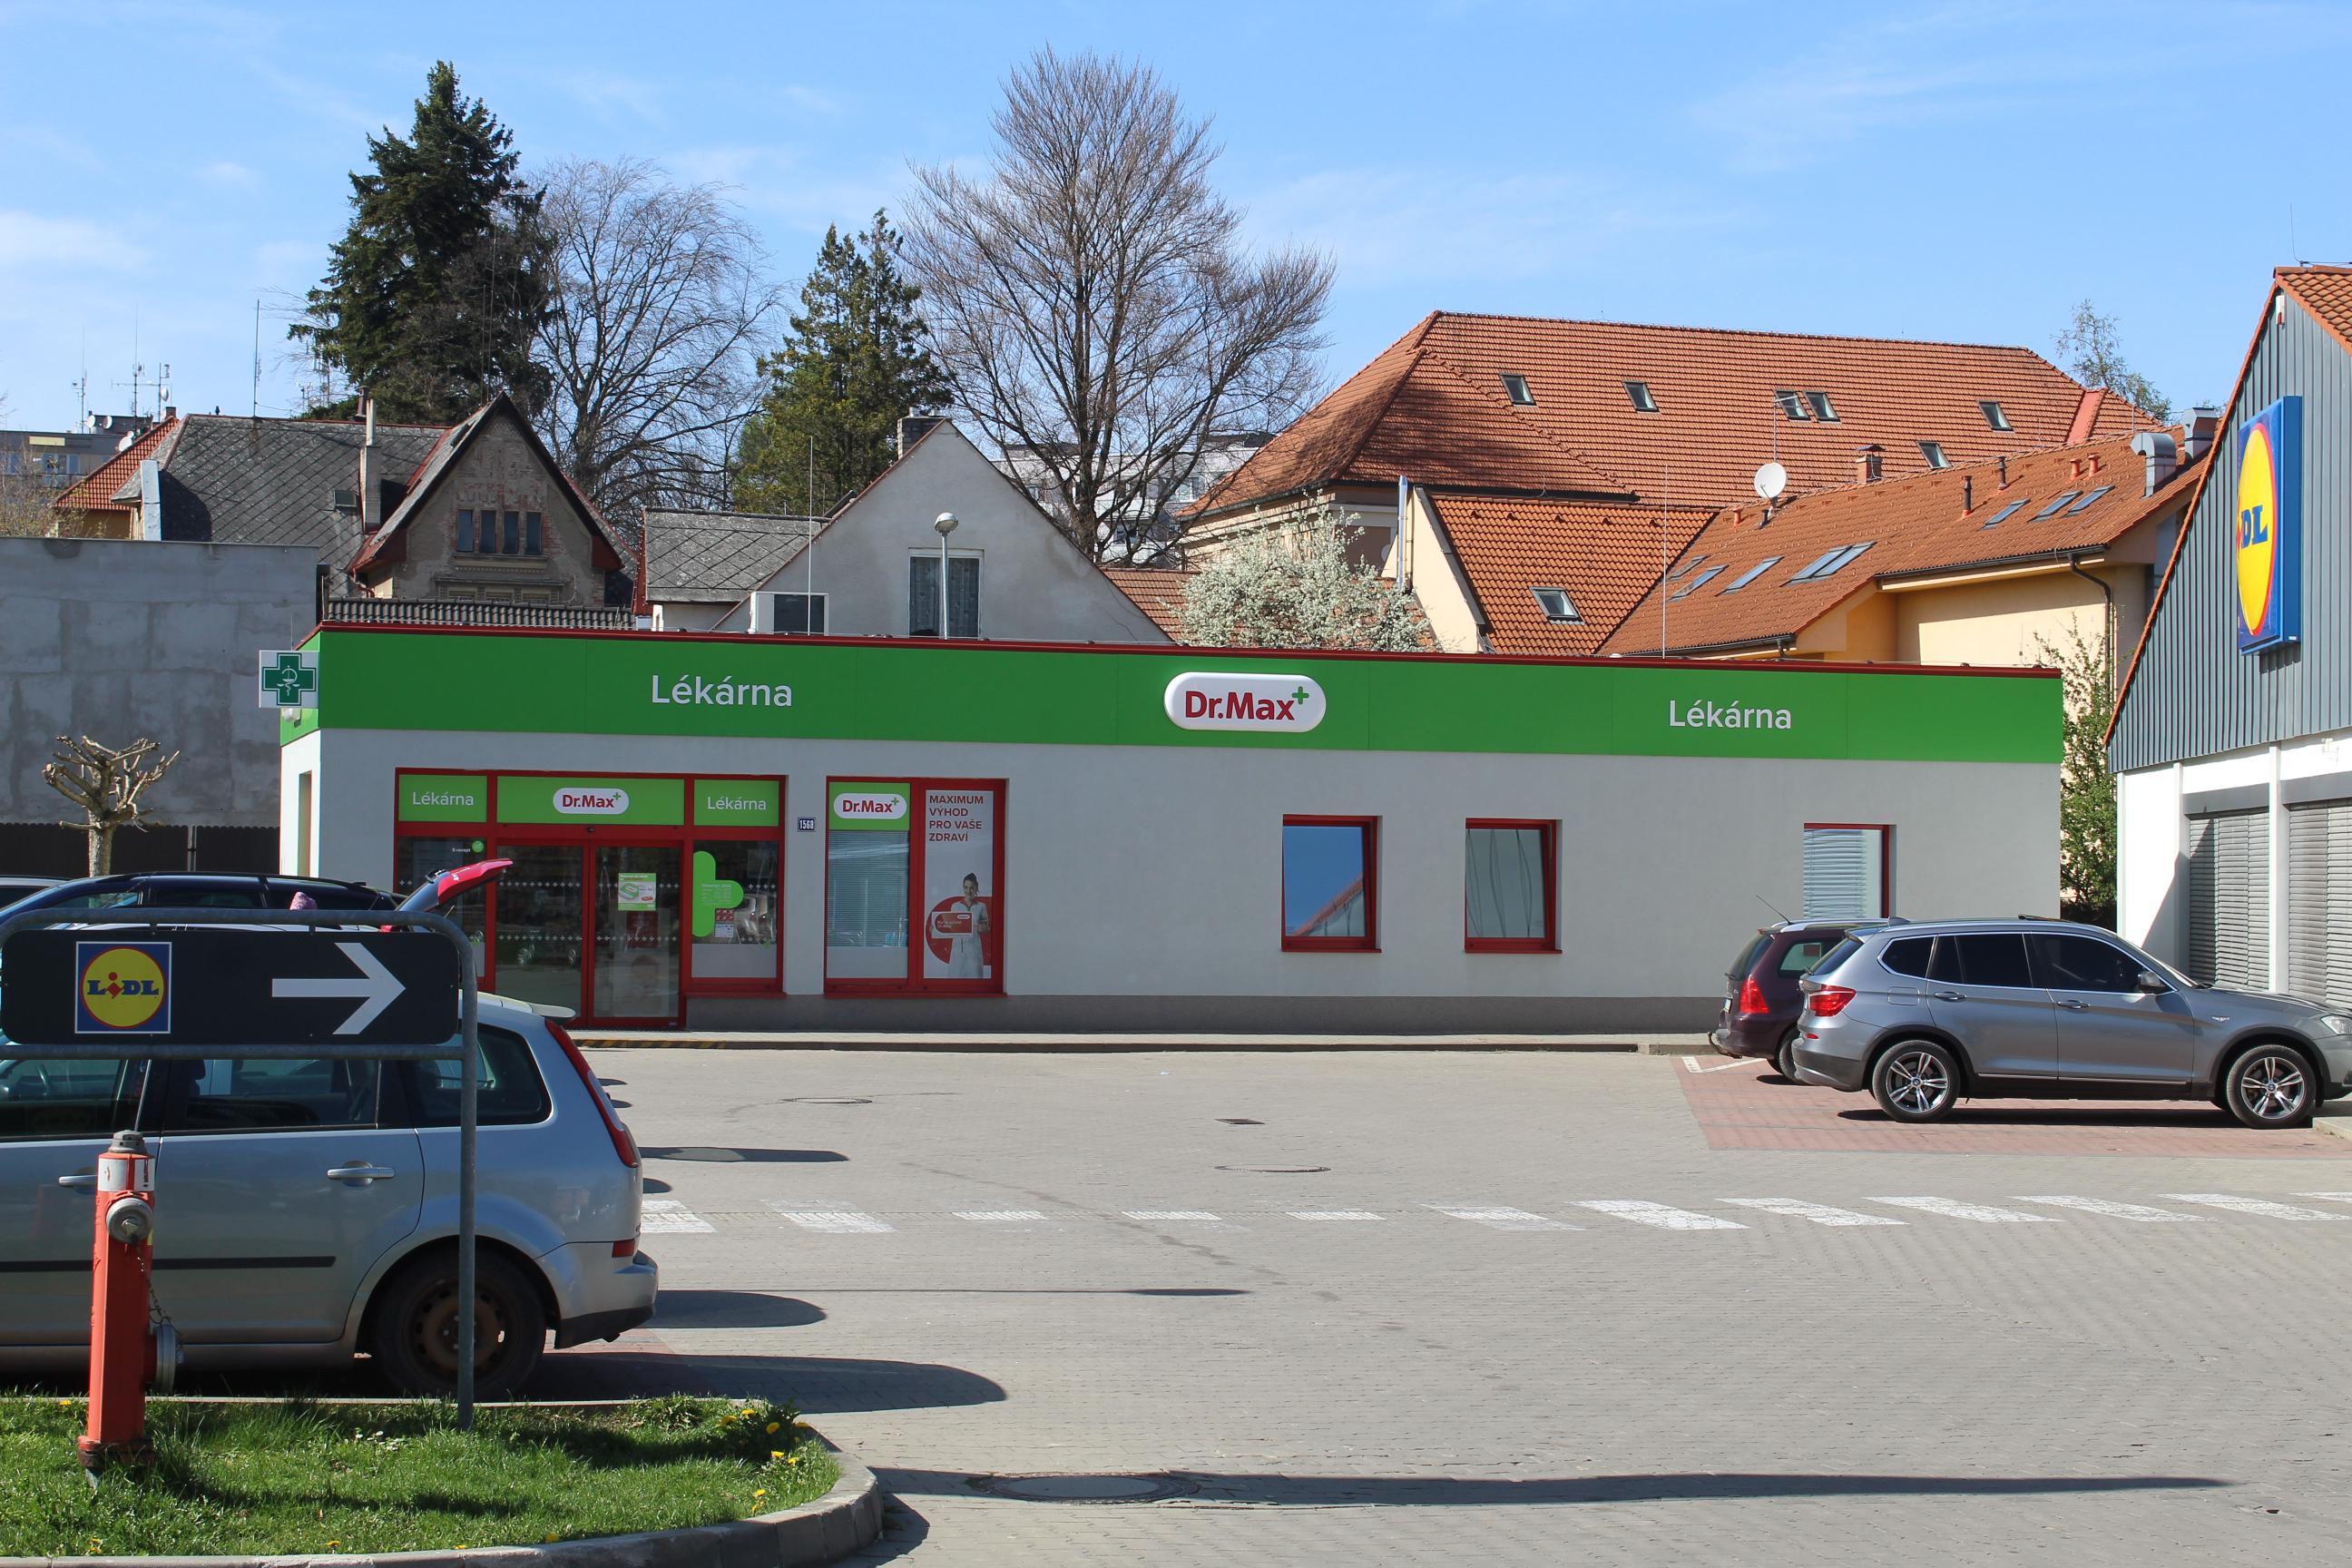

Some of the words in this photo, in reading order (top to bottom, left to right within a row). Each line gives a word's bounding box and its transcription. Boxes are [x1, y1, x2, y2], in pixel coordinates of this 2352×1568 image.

[652, 674, 792, 707] Lékárna
[1670, 699, 1791, 730] Lékárna
[413, 791, 474, 806] Lékárna
[707, 796, 767, 810] Lékárna
[929, 795, 984, 805] MAXIMUM
[929, 806, 968, 817] VÝHOD
[929, 819, 951, 829] PRO
[955, 818, 982, 829] VAŠE
[929, 830, 968, 842] ZDRAVÍ
